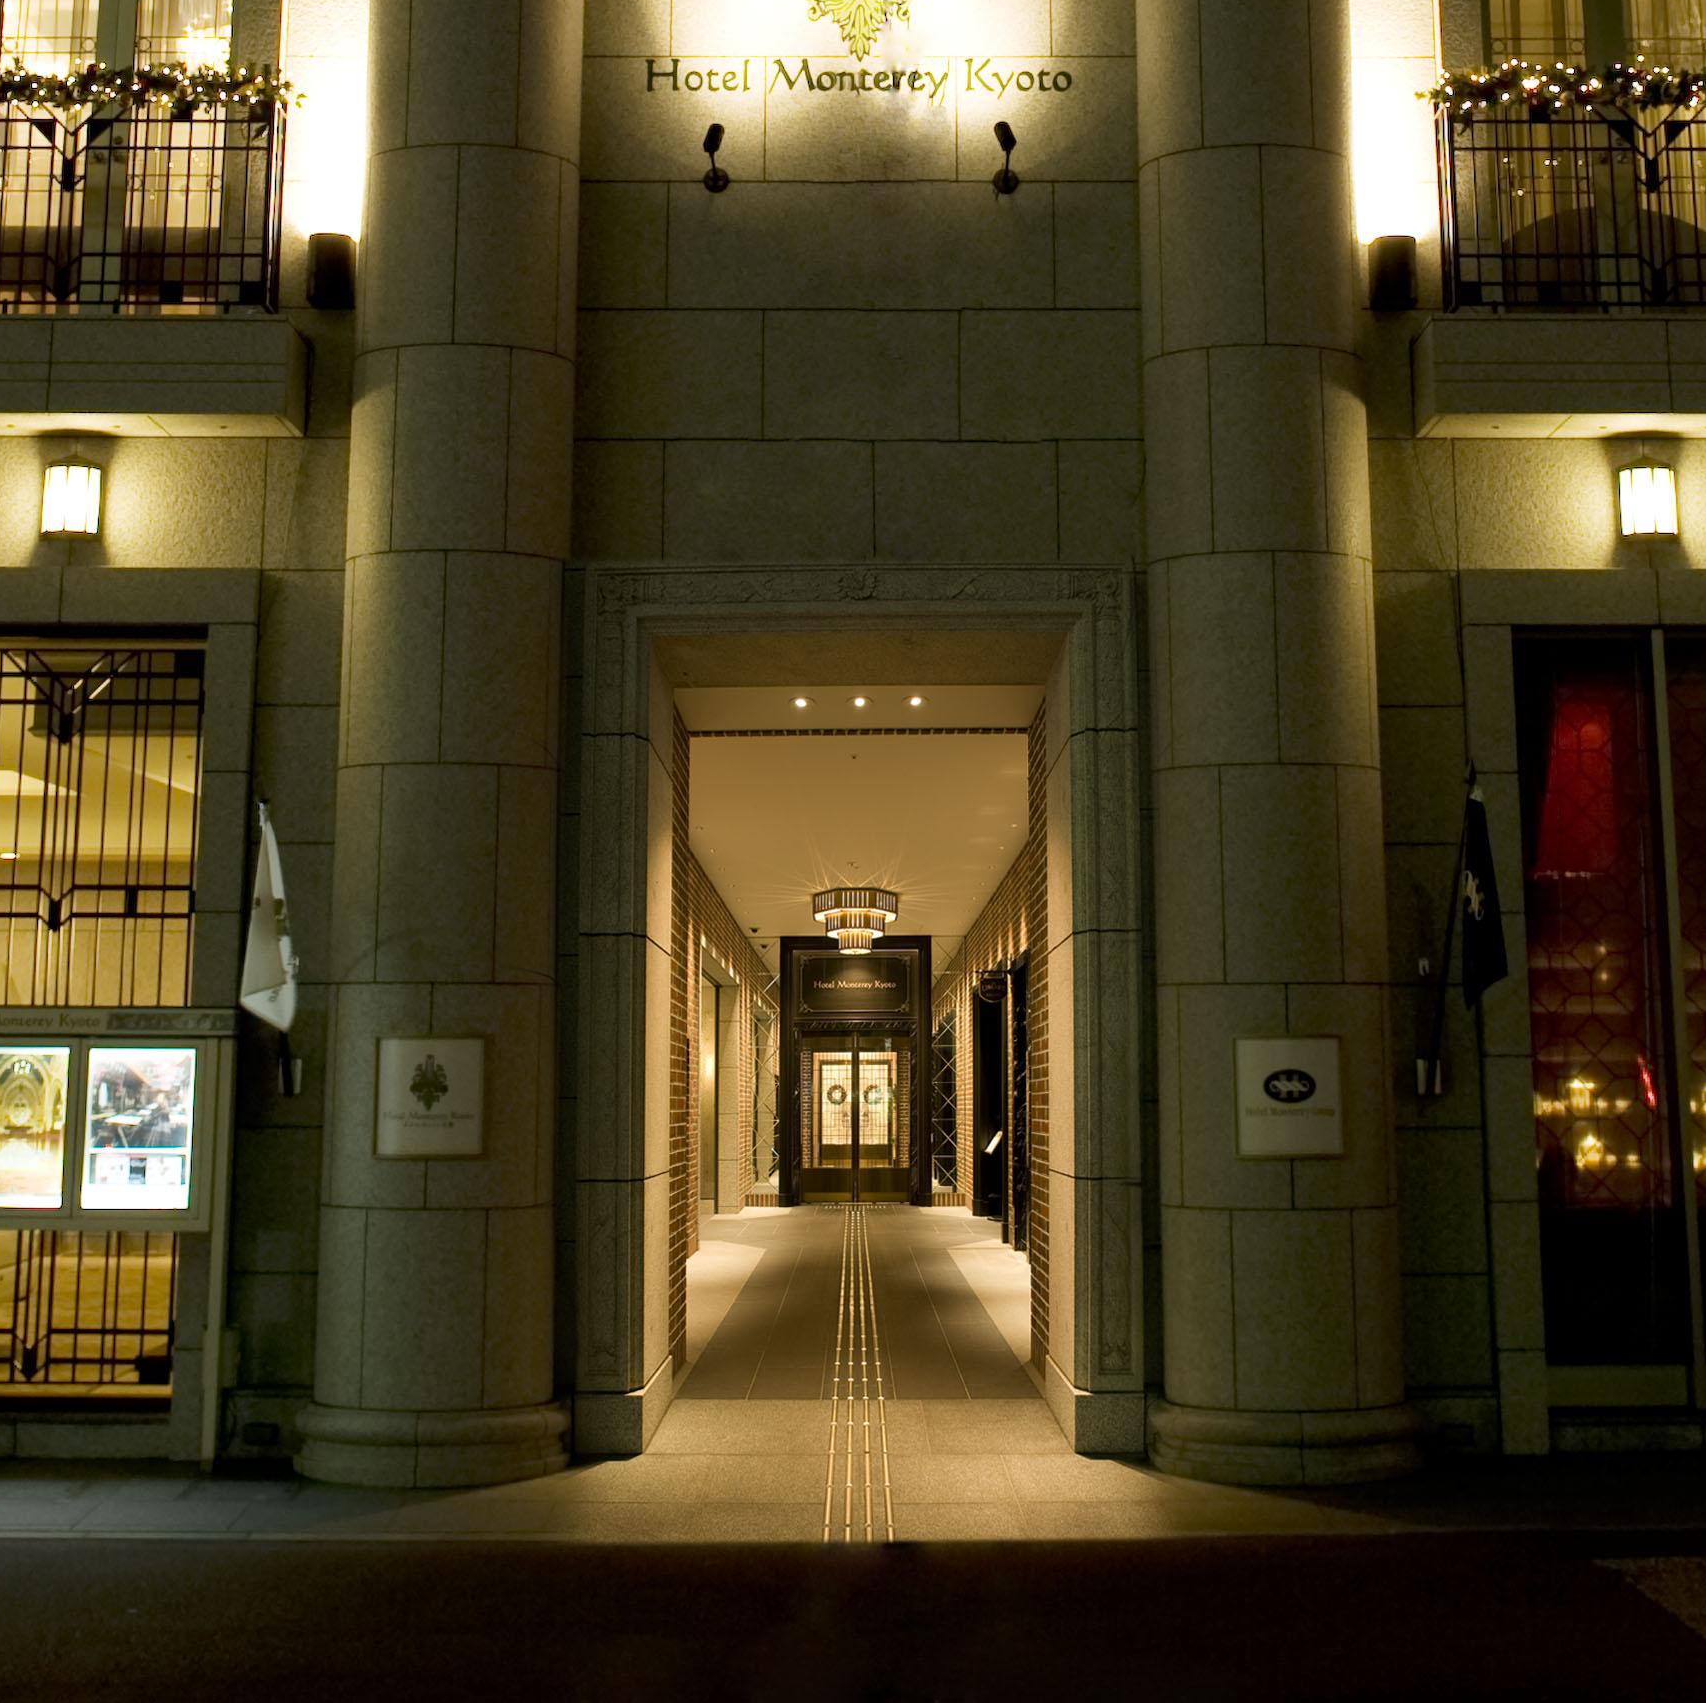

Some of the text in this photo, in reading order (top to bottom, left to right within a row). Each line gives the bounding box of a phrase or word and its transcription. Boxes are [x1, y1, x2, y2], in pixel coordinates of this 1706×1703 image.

[645, 58, 1072, 99] Hotel Monterey Kyoto
[813, 980, 897, 990] Hotel Monterey Kyoto
[59, 1012, 100, 1028] Kyoto
